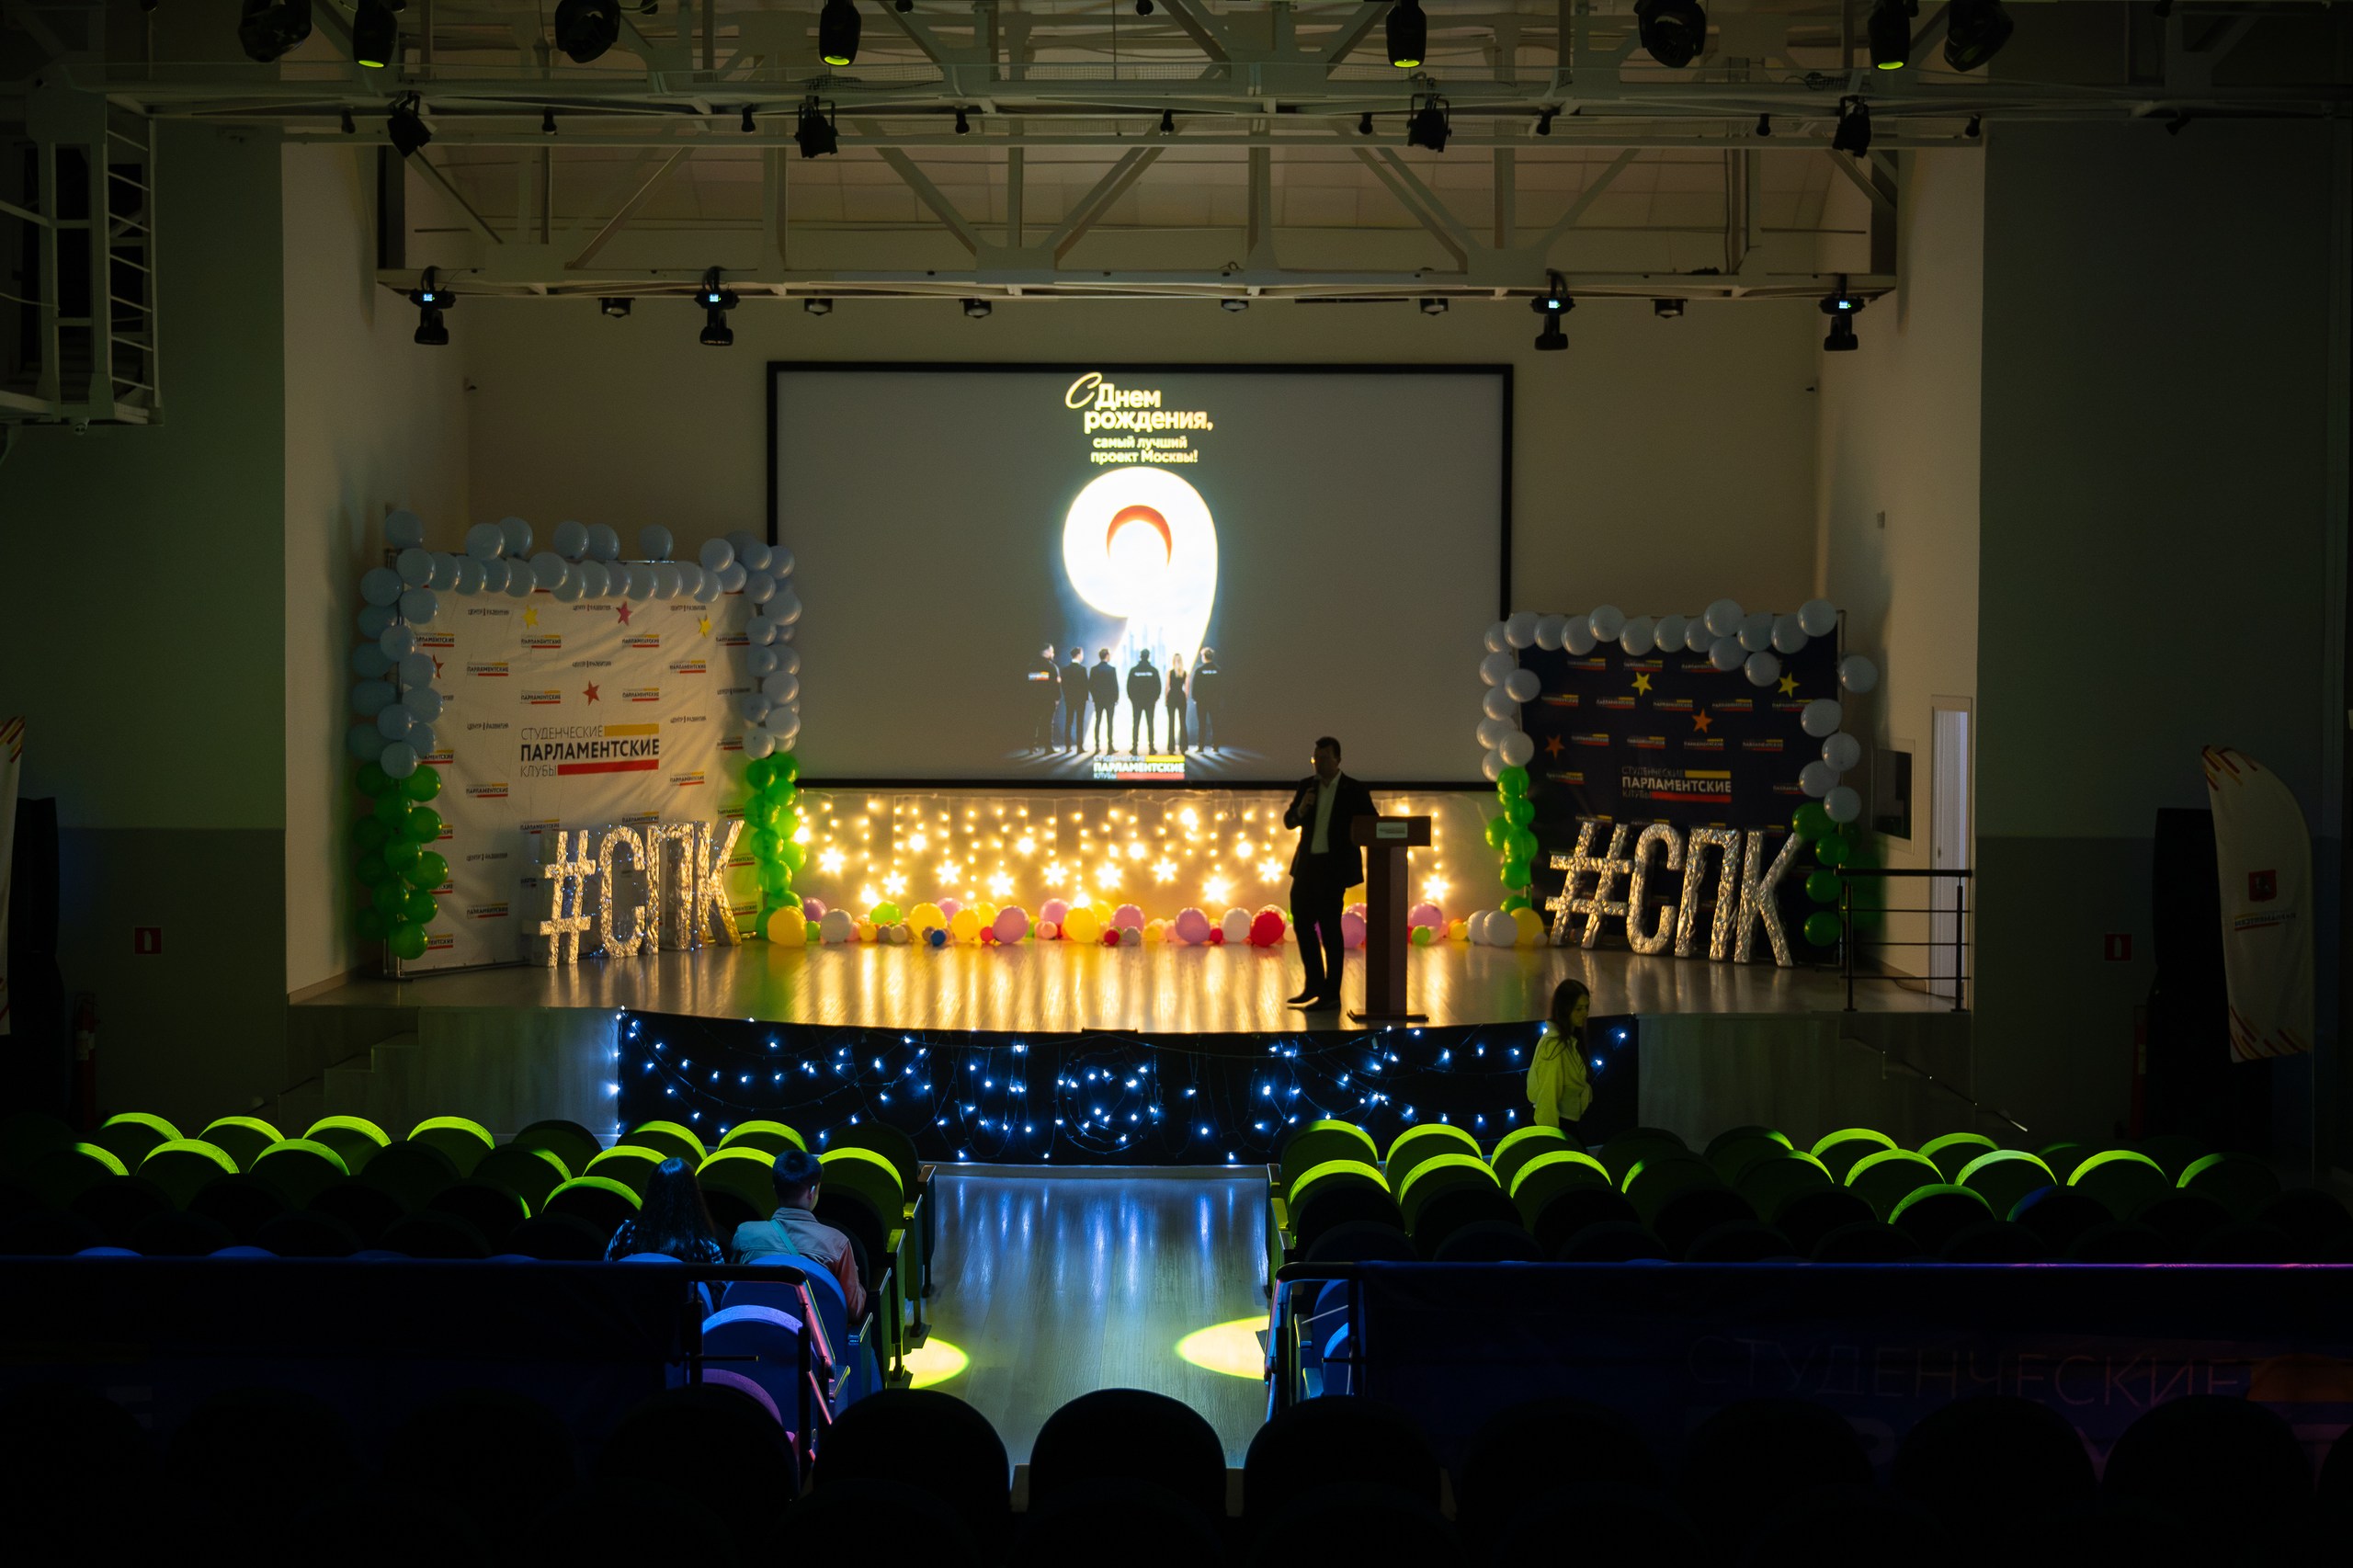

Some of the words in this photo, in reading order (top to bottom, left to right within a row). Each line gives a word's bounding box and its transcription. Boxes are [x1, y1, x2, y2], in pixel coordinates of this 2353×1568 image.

[1064, 371, 1103, 409] С
[1094, 382, 1162, 411] Днем
[1084, 411, 1214, 434] рождения,
[1092, 436, 1135, 449] самый
[1136, 436, 1188, 450] лучший
[1090, 449, 1139, 465] проект
[1141, 449, 1199, 463] Москвы!
[520, 725, 603, 740] СТУДЕНЧЕСКИЕ
[520, 739, 660, 761] ПАРЛАМЕНТСКИЕ
[520, 765, 557, 778] КЛУБЫ
[1093, 762, 1186, 773] ПАРЛАМЕНТСКИЕ
[1621, 776, 1732, 793] ПАРЛАМЕНТСКИЕ
[540, 818, 745, 968] #СПК
[1544, 820, 1804, 967] #СПК
[1688, 1335, 2239, 1409] СТУДЕНЧЕСКИЕ
